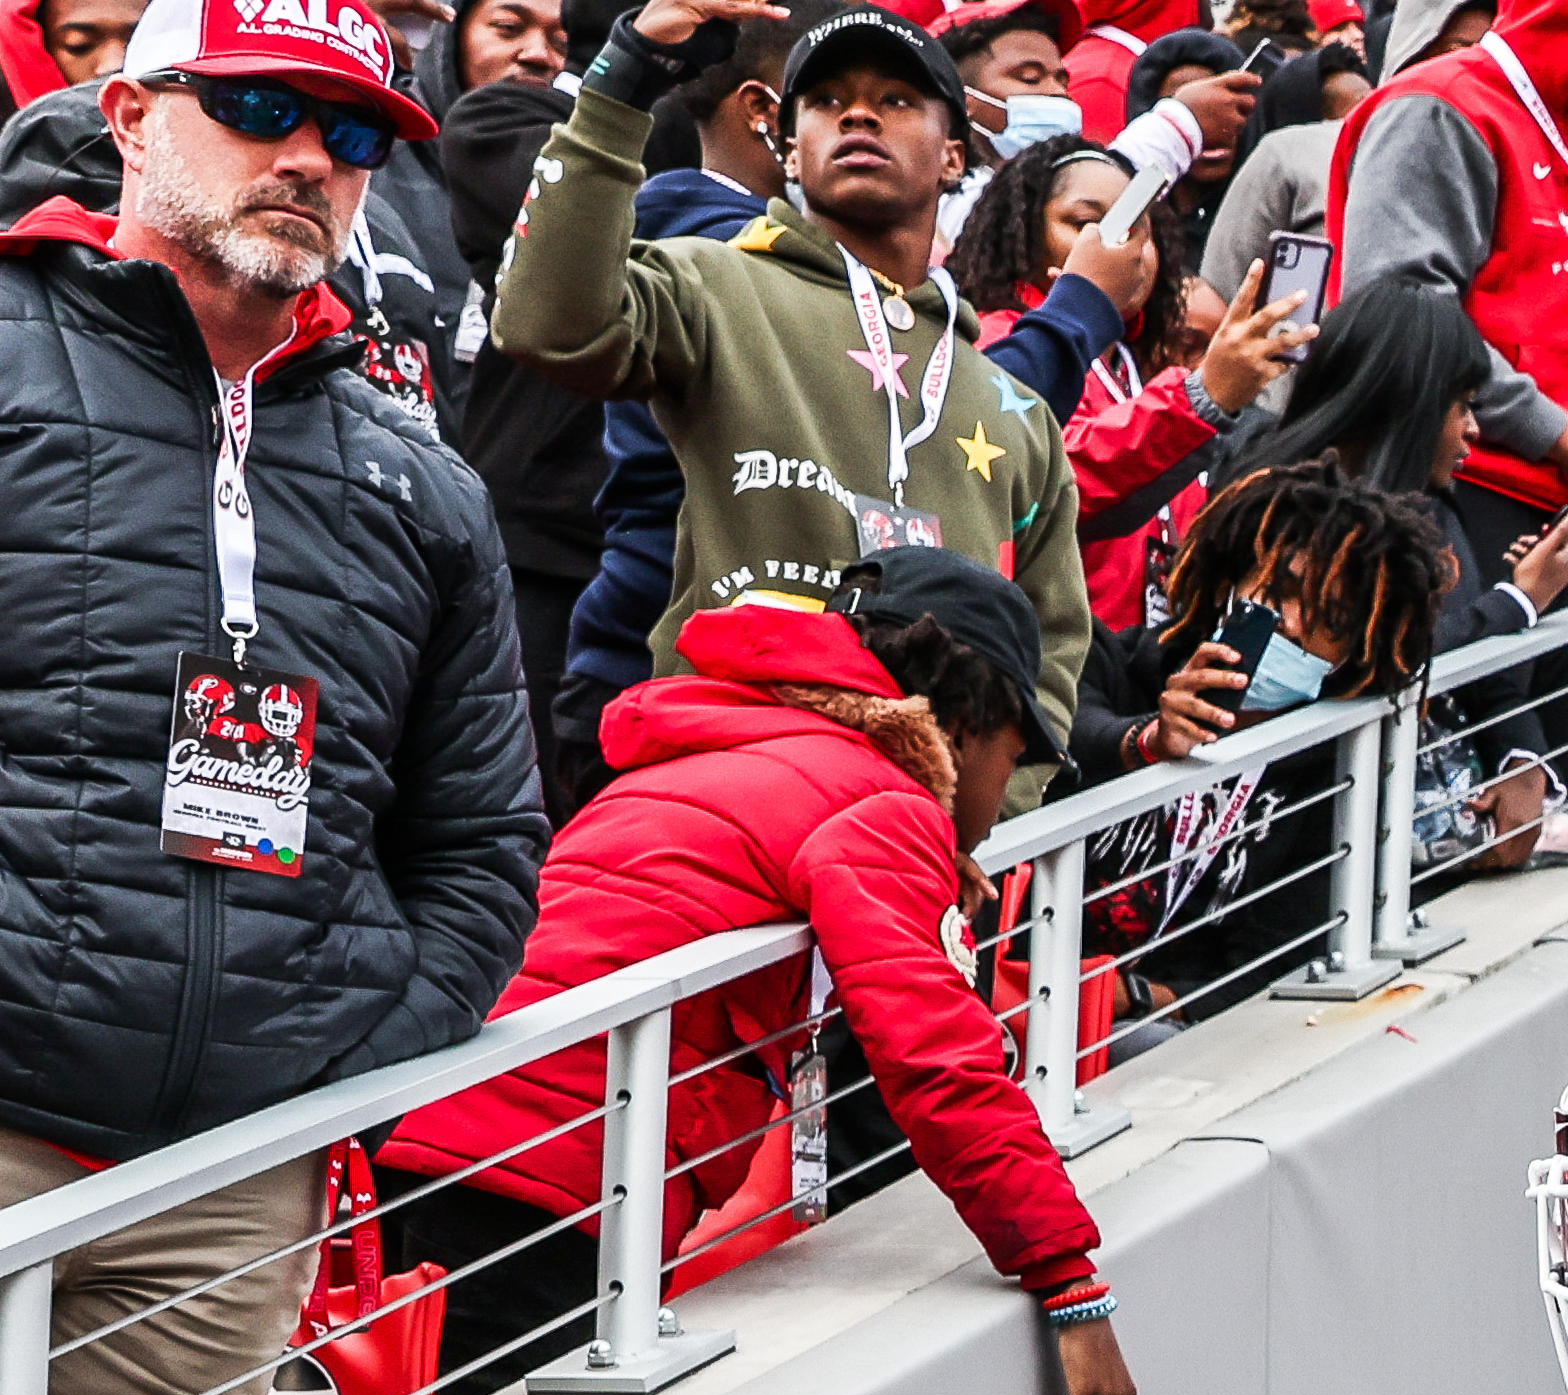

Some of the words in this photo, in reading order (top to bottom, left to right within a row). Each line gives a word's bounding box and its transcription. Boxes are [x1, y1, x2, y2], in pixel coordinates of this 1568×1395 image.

[858, 290, 889, 368] GEORGIA
[167, 738, 311, 812] Gameday
[183, 802, 211, 815] MIKE
[215, 810, 259, 825] BROWN
